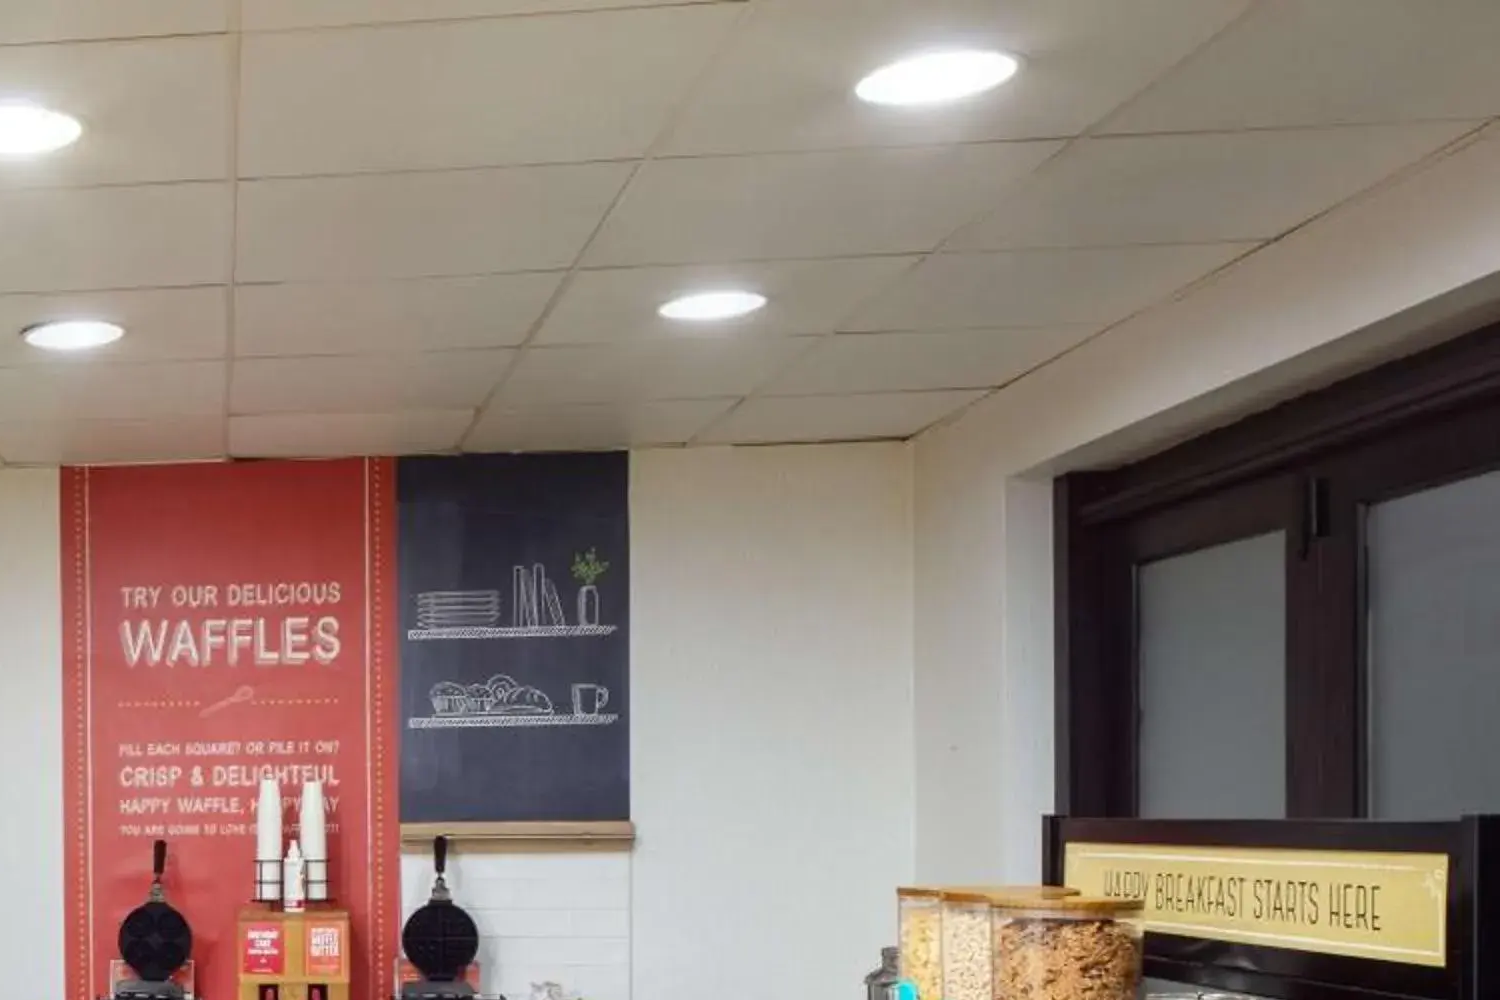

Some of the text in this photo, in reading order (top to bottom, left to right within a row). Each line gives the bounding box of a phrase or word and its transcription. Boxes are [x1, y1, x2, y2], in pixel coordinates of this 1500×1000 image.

[120, 581, 341, 608] TRY OUR DELICIOUS
[119, 616, 341, 668] WAFFLES
[119, 743, 143, 757] FILL
[147, 743, 180, 755] EACH
[245, 741, 265, 755] OR
[269, 741, 295, 755] PILE
[299, 741, 309, 753] IT
[120, 764, 341, 788] CRISP & DELIGHTFUL
[119, 797, 171, 815] HAPPY
[177, 797, 245, 815] WAFFLE,
[1155, 873, 1246, 918] BREAKFAST
[1253, 879, 1319, 925] STARTS
[1328, 883, 1382, 931] HERE
